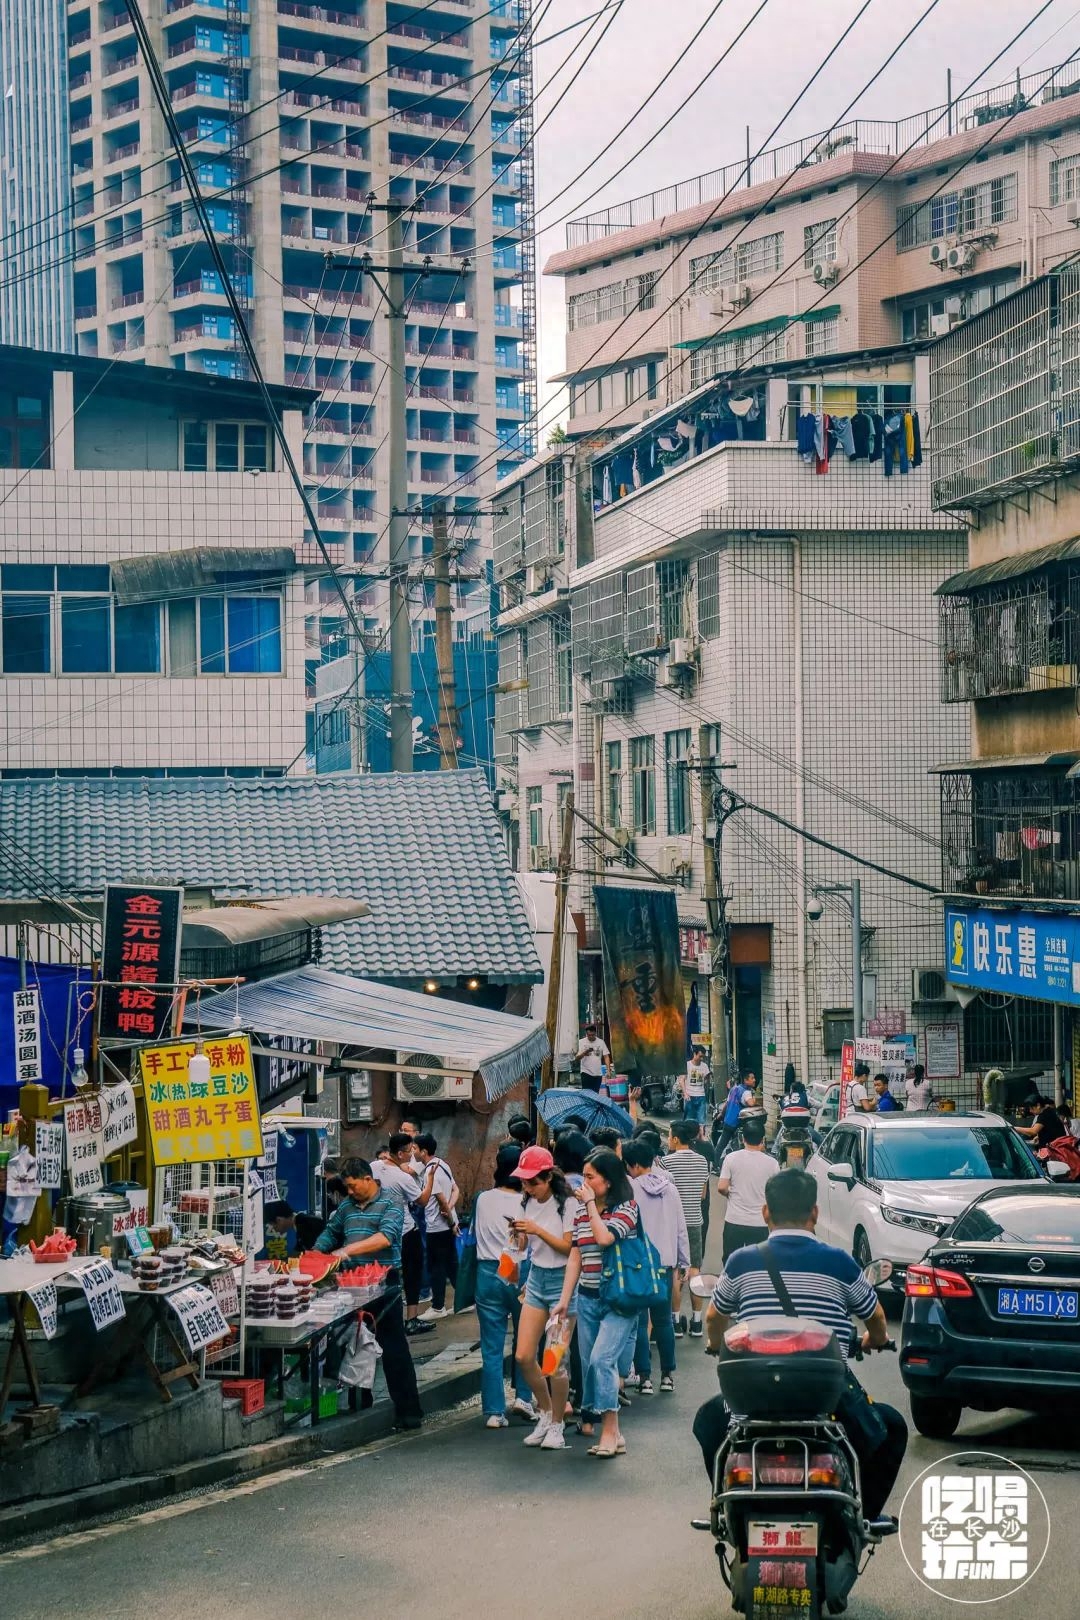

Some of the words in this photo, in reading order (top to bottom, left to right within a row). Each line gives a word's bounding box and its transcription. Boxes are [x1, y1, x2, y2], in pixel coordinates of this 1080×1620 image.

[117, 894, 163, 1033] 金元源酱板鸭
[973, 921, 1037, 979] 快乐惠
[15, 992, 38, 1079] 甜酒汤圆蛋
[153, 1100, 252, 1131] 甜酒丸子蛋
[753, 1586, 812, 1606] 南湖路专卖
